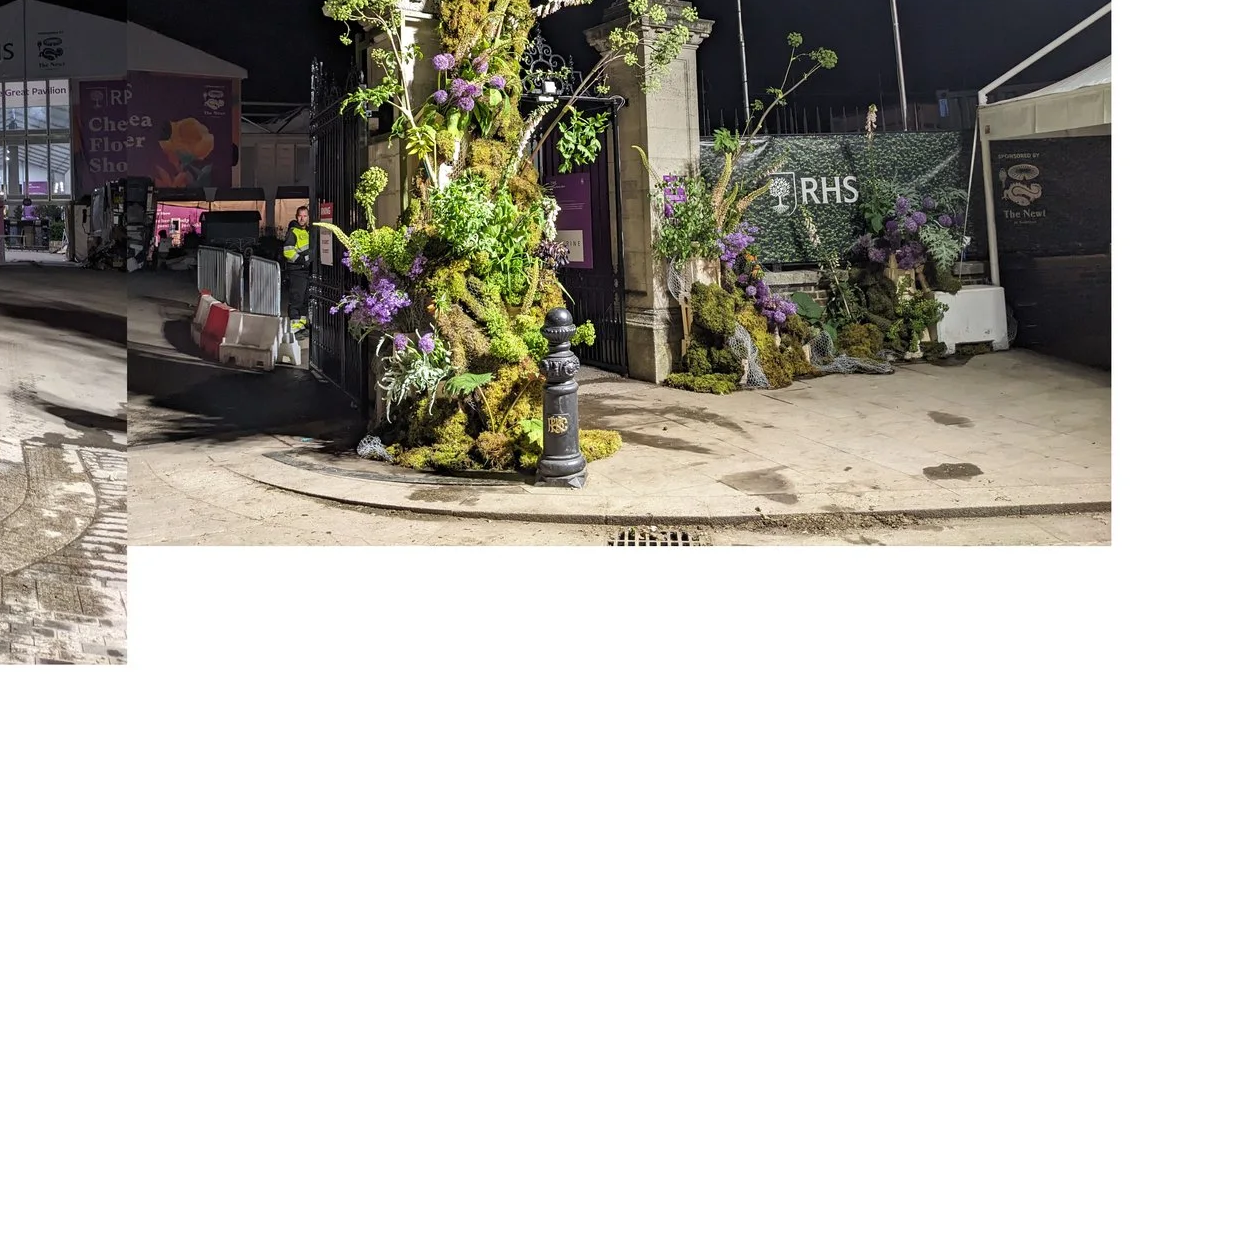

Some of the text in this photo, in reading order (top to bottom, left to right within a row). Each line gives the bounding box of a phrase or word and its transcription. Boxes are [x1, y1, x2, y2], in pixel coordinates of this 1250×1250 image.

[4, 88, 30, 97] Great
[32, 86, 67, 96] Pavlion
[800, 176, 859, 205] RHS
[1003, 209, 1047, 219] The Newt
